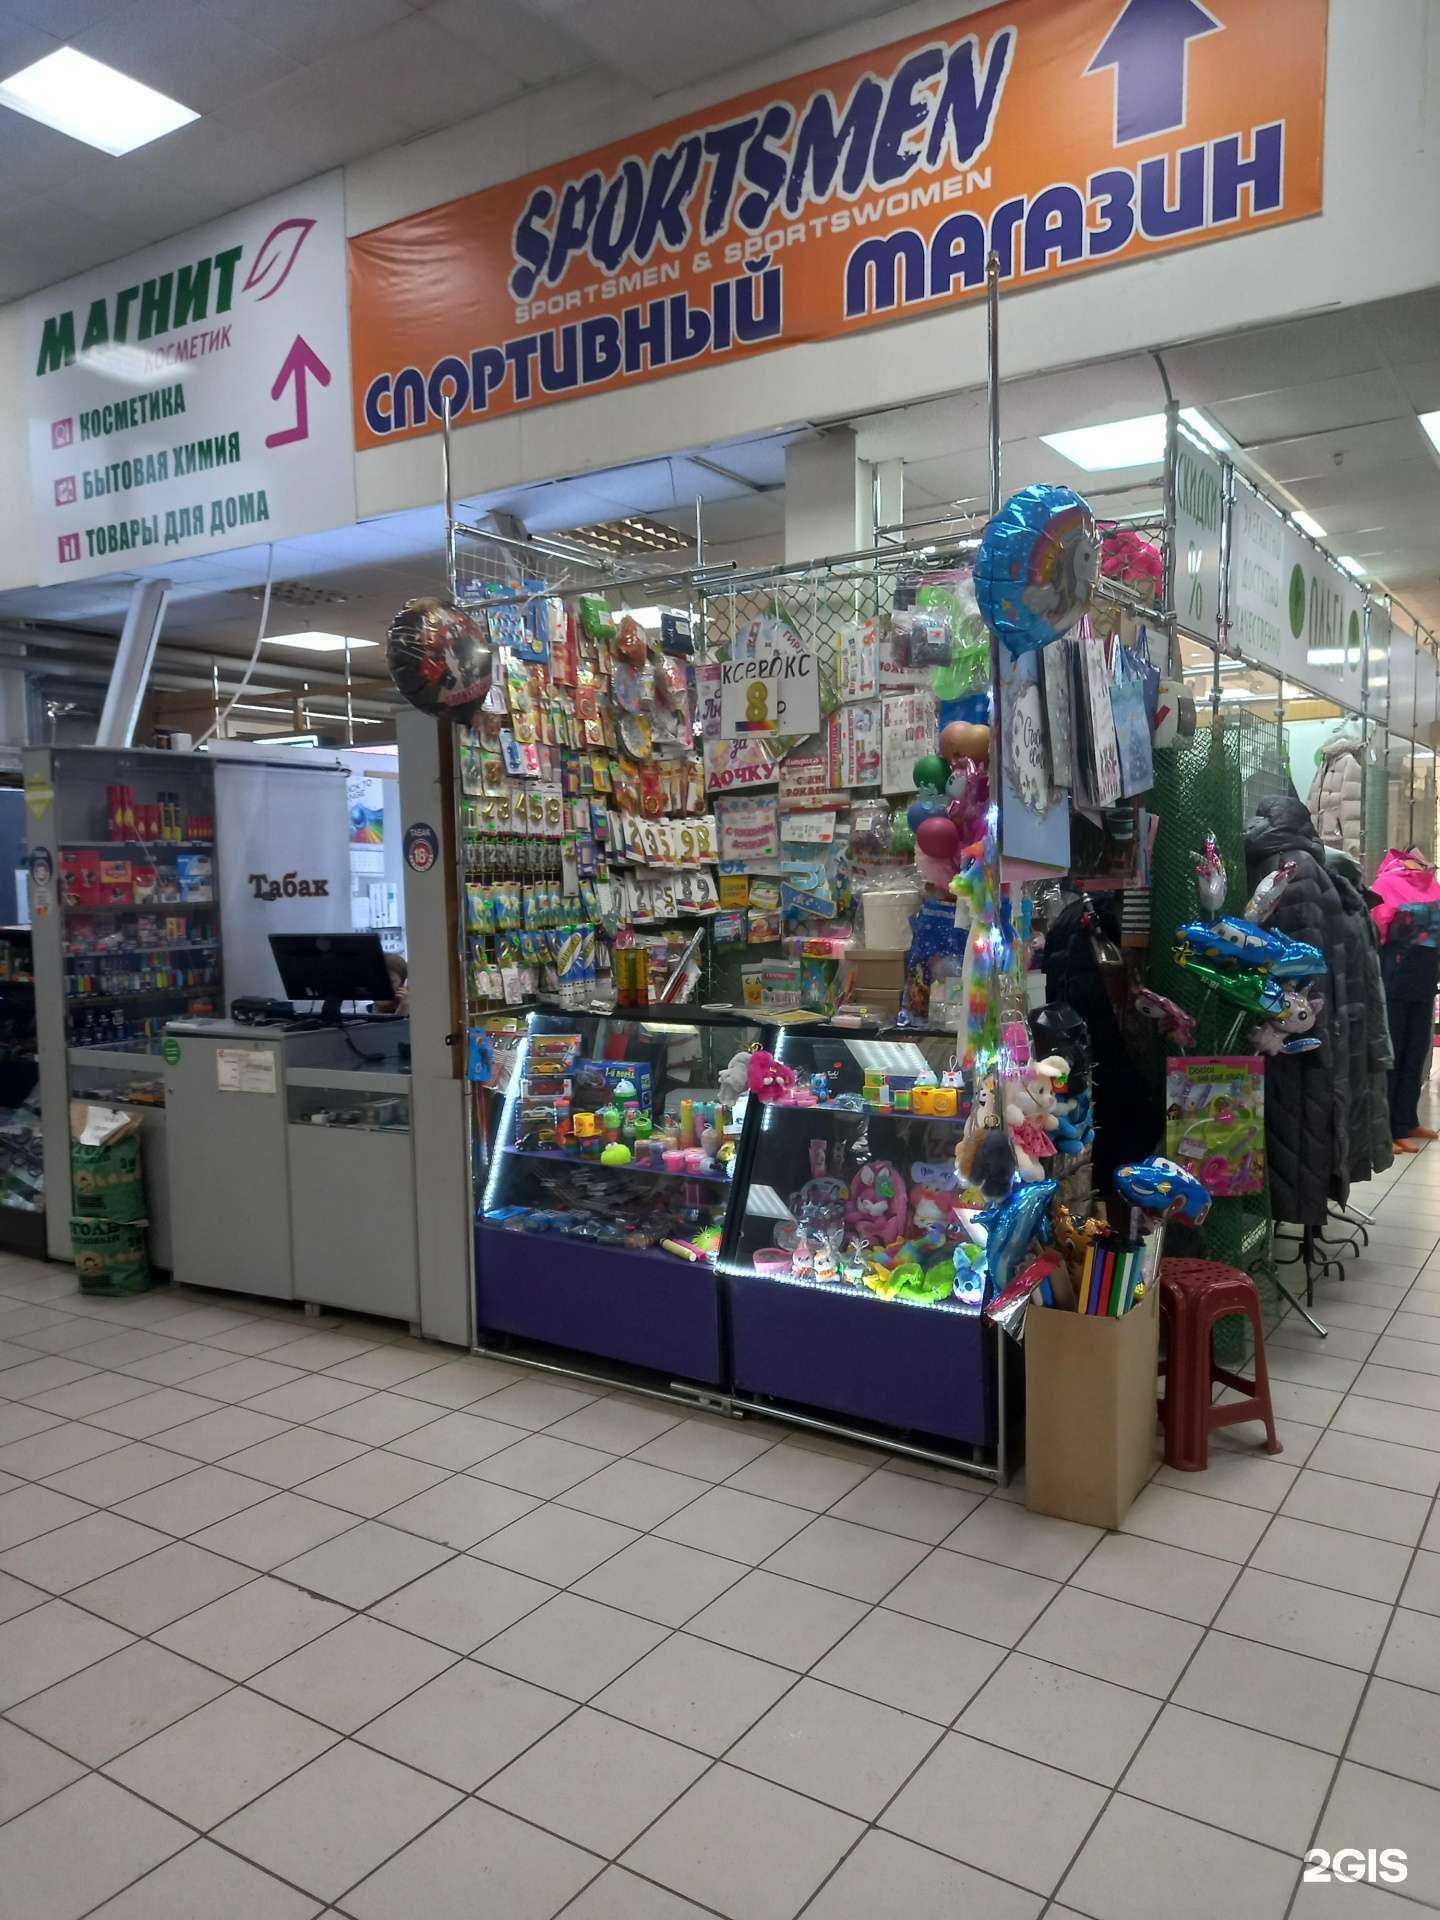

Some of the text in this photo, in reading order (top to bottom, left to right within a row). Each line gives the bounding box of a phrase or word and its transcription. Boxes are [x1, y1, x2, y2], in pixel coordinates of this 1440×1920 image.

[509, 26, 1018, 302] SPORTSMEN
[364, 118, 1287, 437] СПОРТИВНЫЙ МАГАЗИН
[514, 166, 993, 325] SPORTSMEN & SPORTSWOMEN
[36, 245, 243, 377] МАГНИТ
[79, 383, 186, 443] КОСМЕТИКА
[82, 431, 241, 501] БЫТОВАЯ ХИМИЯ
[85, 489, 270, 559] ТОВАРЫ ДЛЯ ДОМА
[707, 763, 775, 791] ДОЧКУ
[248, 870, 329, 900] Табак
